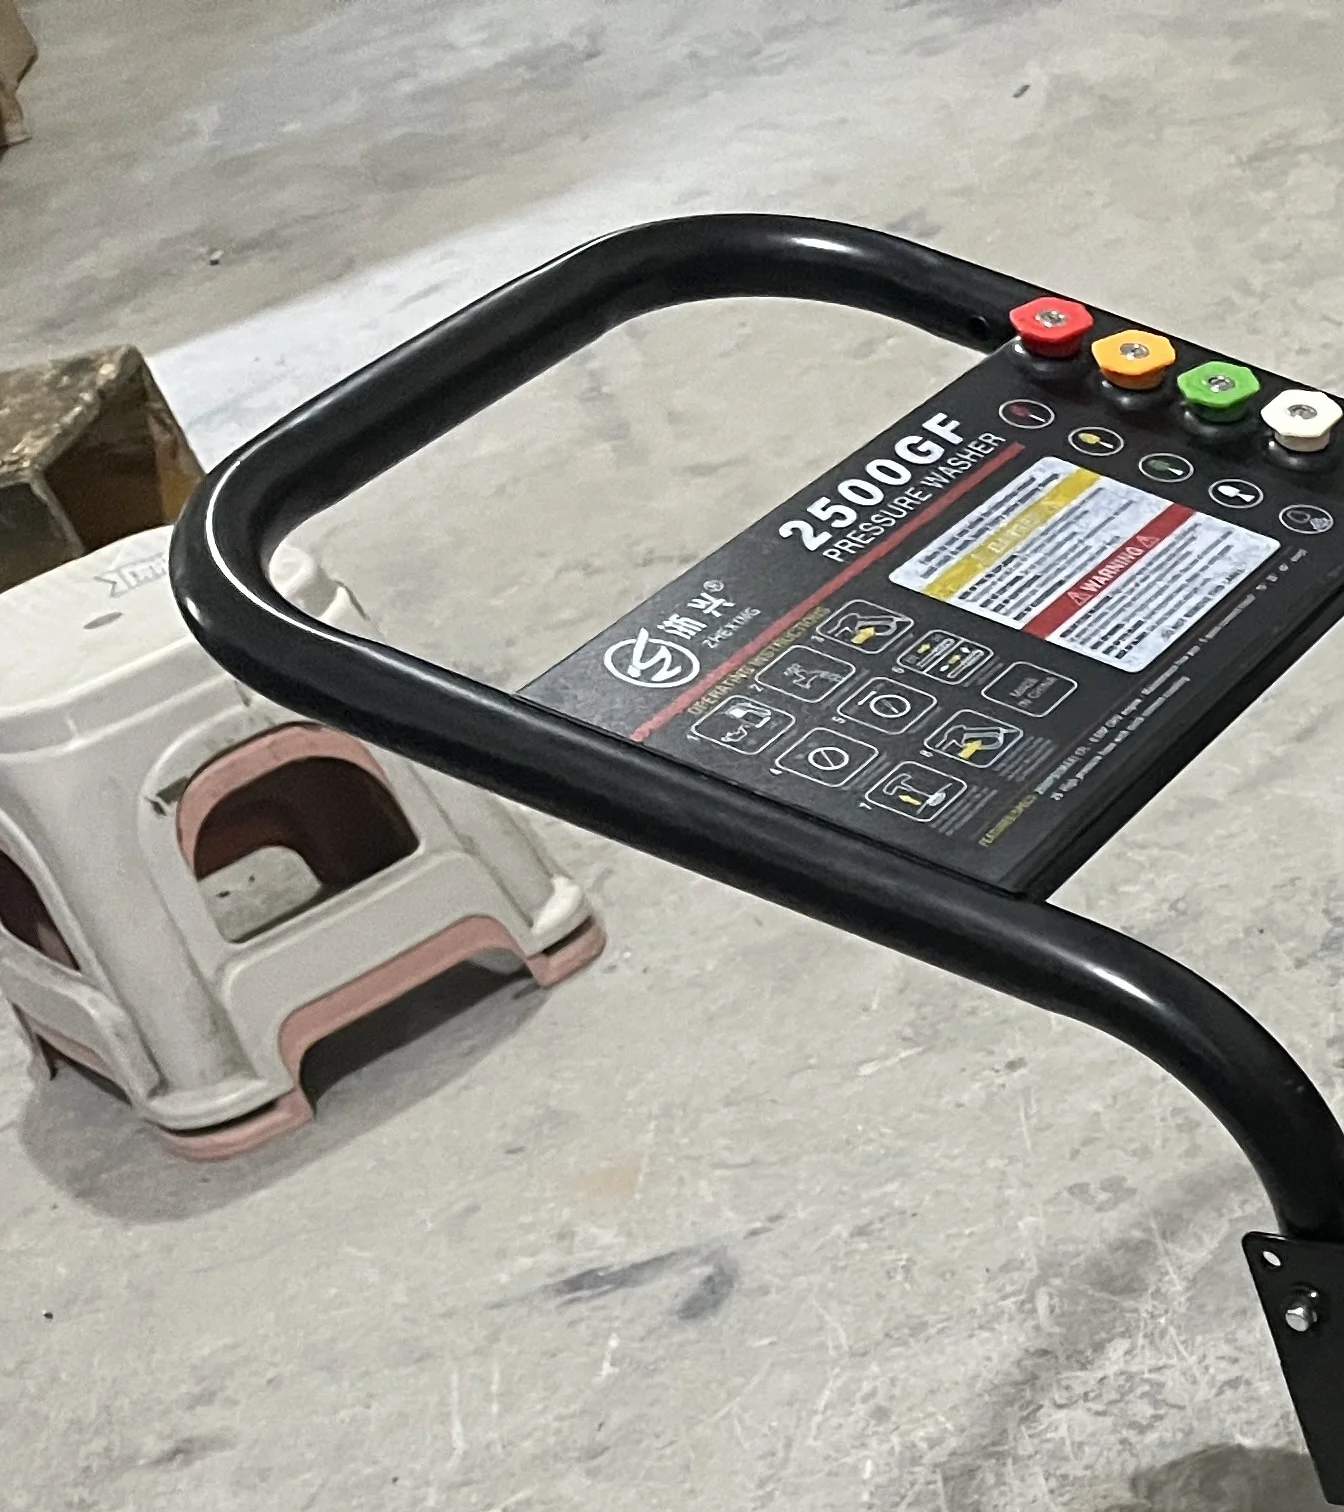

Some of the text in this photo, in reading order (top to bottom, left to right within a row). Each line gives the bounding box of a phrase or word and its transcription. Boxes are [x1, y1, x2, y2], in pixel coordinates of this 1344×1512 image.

[779, 412, 964, 551] 2500GF
[823, 487, 933, 562] PRESSURE
[920, 432, 1007, 489] WASHER
[1080, 546, 1143, 594] WARNING
[687, 606, 832, 716] OPERATING INSTRUCTIONS
[702, 607, 762, 648] ZHEXING
